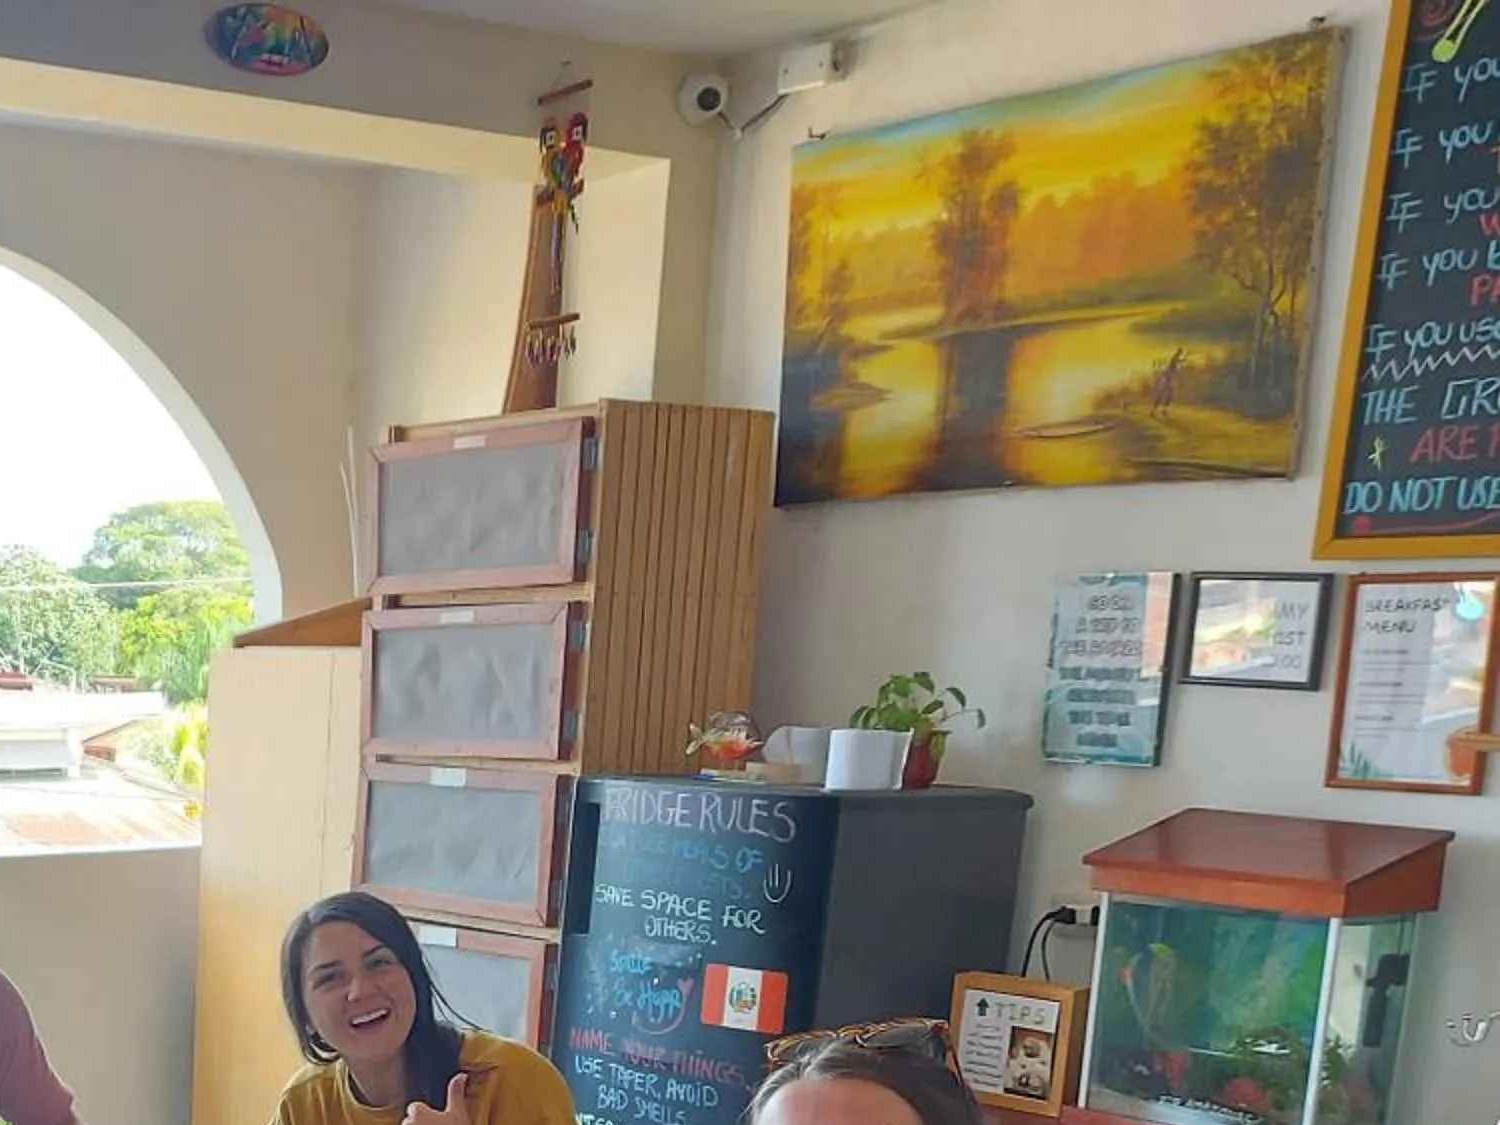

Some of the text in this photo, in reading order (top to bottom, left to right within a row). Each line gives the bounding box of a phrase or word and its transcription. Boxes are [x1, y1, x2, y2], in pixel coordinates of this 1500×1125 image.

[1361, 384, 1421, 426] THE
[1409, 424, 1480, 465] ARE
[1343, 480, 1383, 515] DO
[1388, 475, 1459, 514] NOT
[1365, 619, 1417, 634] MENU
[603, 787, 797, 843] FRIDGE RULES
[594, 883, 767, 934] SAVE SPACE FOR
[995, 1002, 1046, 1025] TIPS
[568, 1026, 616, 1057] NAME
[574, 1055, 605, 1080] USE
[597, 1084, 629, 1111] BAD
